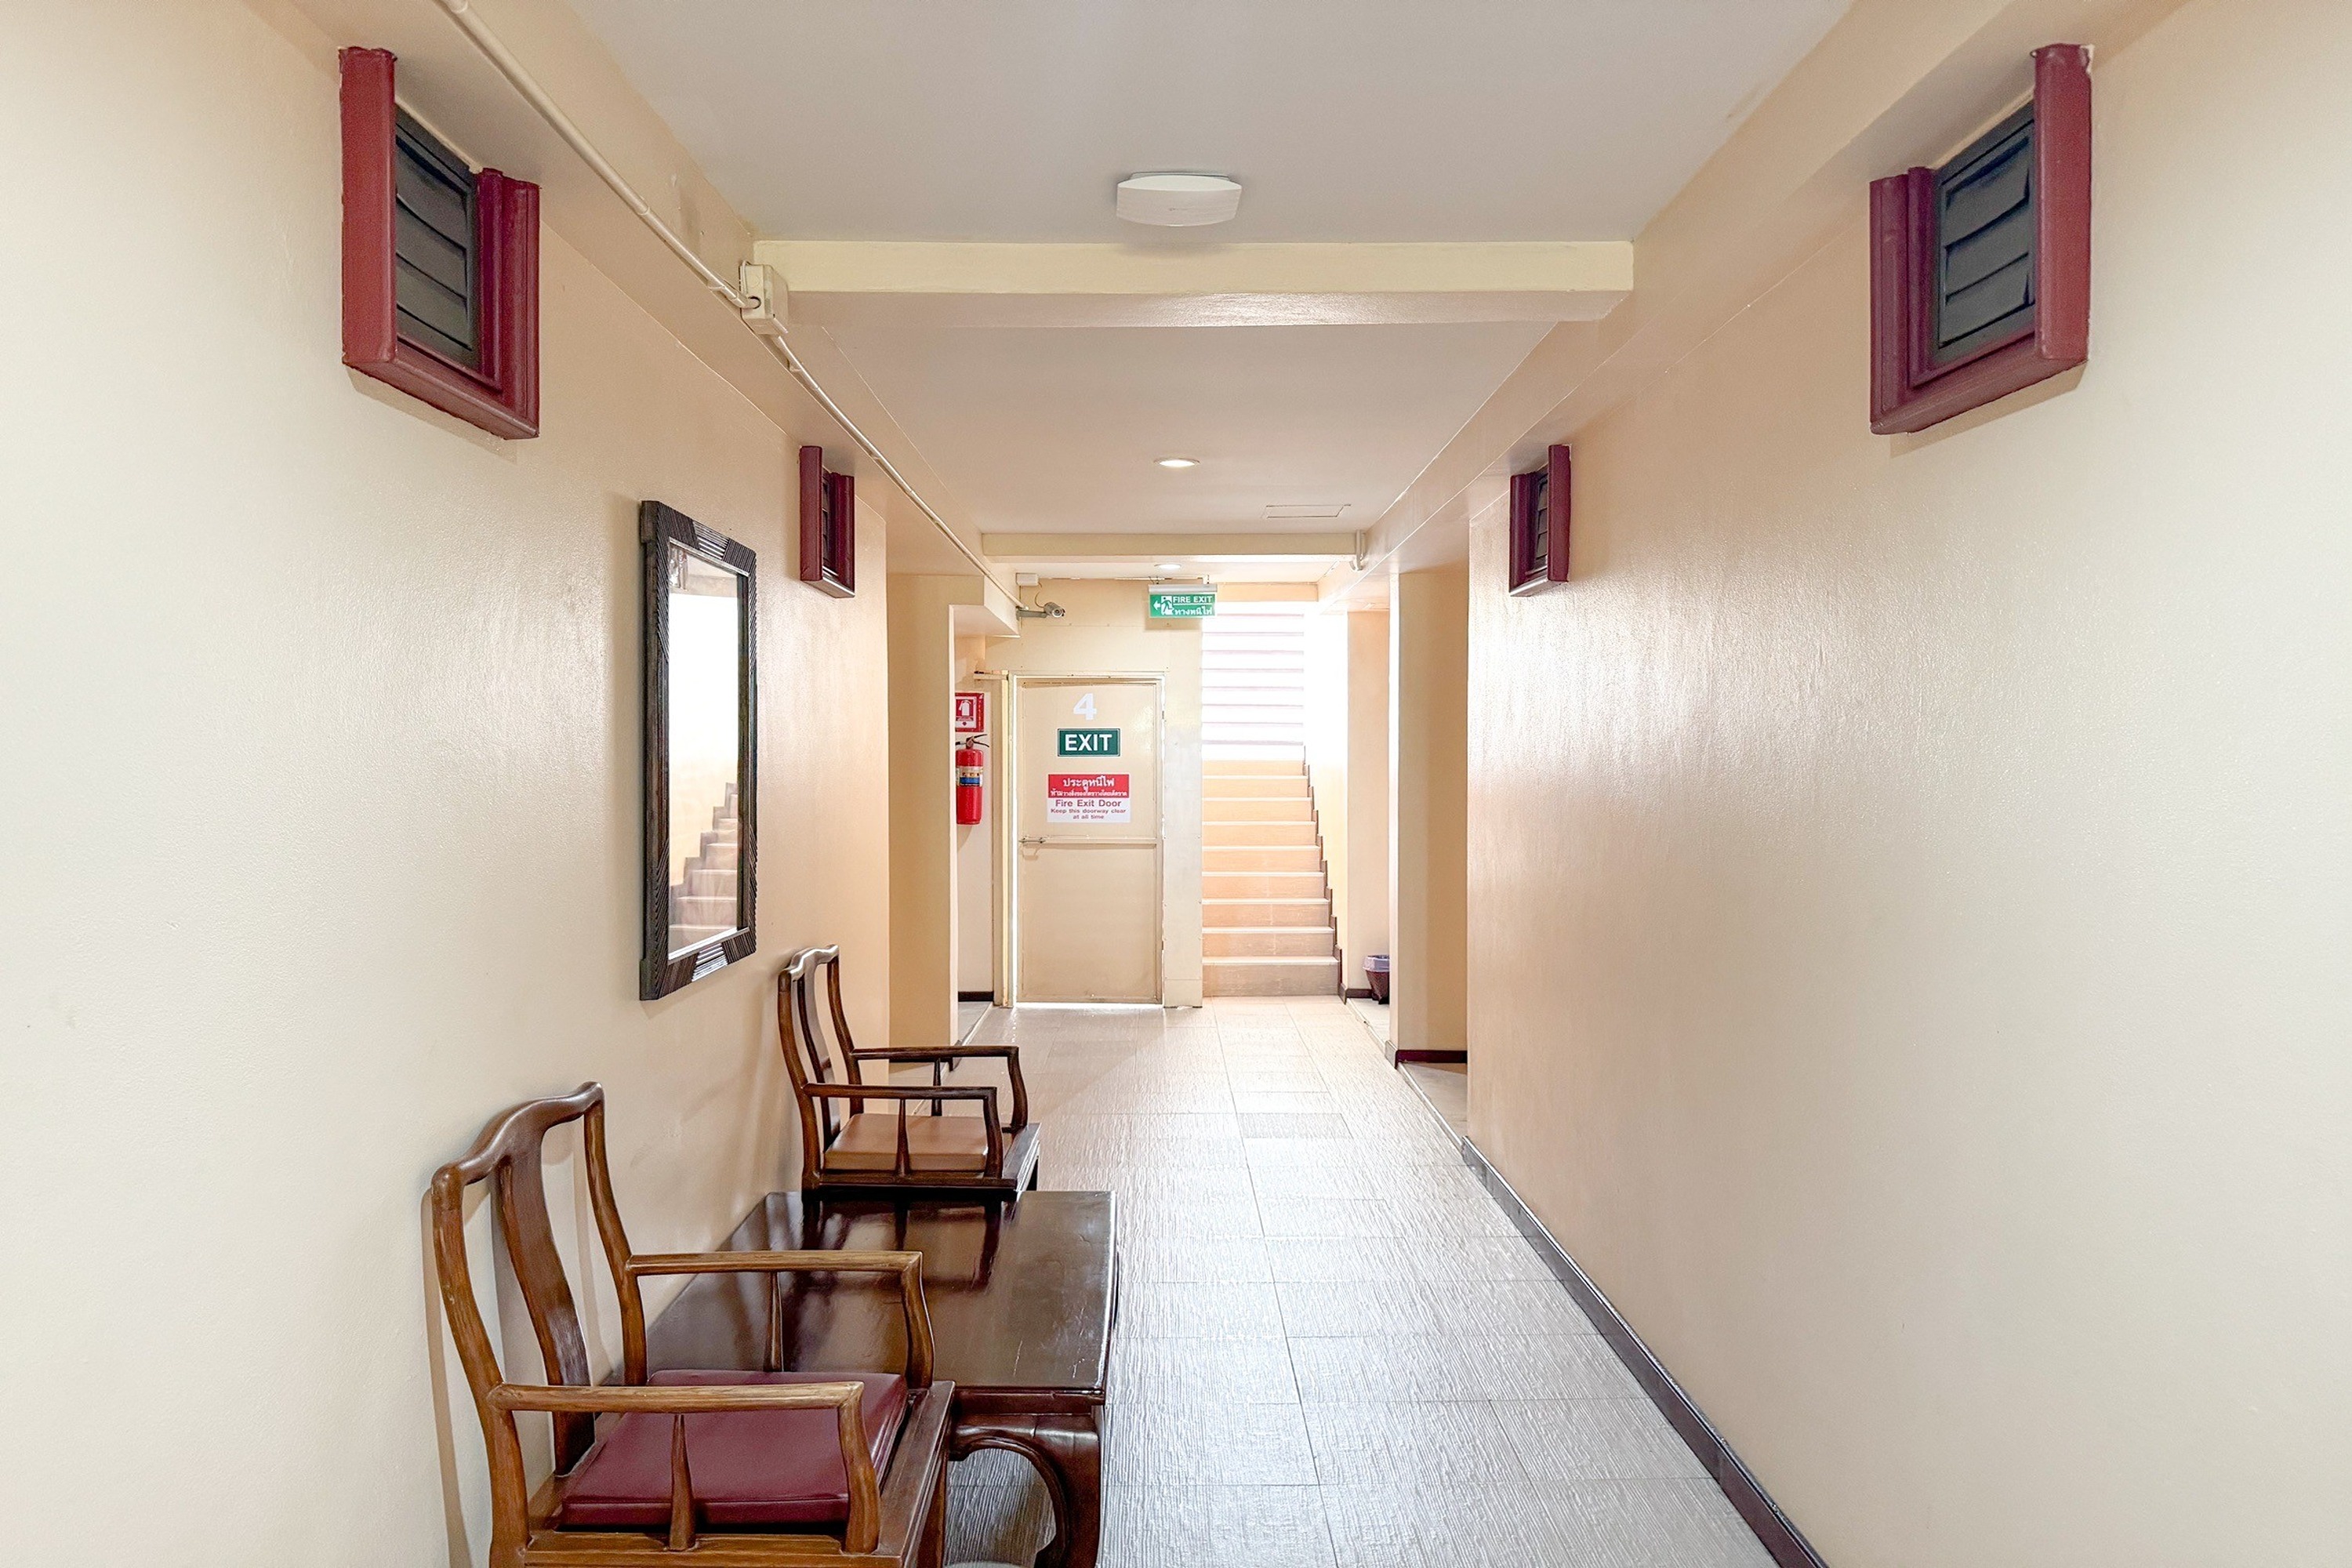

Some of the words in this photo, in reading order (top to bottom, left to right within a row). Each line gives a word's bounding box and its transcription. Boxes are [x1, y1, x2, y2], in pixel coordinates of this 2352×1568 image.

[1174, 605, 1213, 615] ทางหนีไฟ
[1073, 692, 1098, 720] 4
[1065, 734, 1112, 751] EXIT
[1062, 775, 1115, 791] ประตูหนีไฟ
